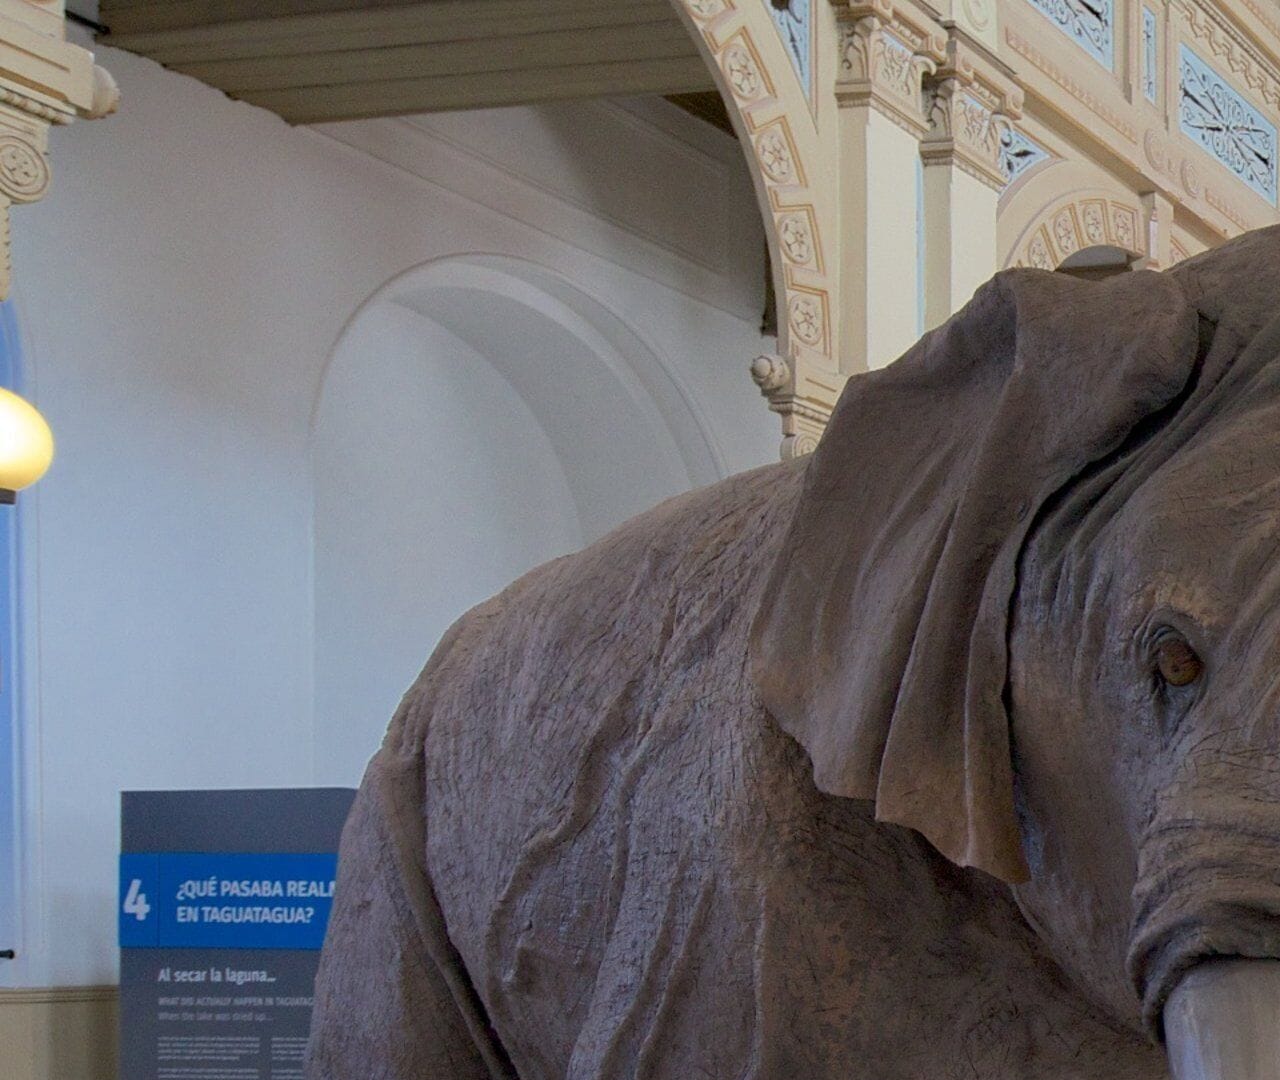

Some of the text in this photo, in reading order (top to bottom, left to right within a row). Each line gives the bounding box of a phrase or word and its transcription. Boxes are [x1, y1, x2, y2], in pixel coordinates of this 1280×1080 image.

[176, 877, 217, 900] ¿QUÉ
[220, 880, 284, 898] PASABA
[122, 878, 150, 921] 4
[177, 906, 314, 924] EN TAGUATAGUA?
[157, 967, 170, 982] Al
[173, 970, 207, 982] secar
[210, 967, 222, 982] la
